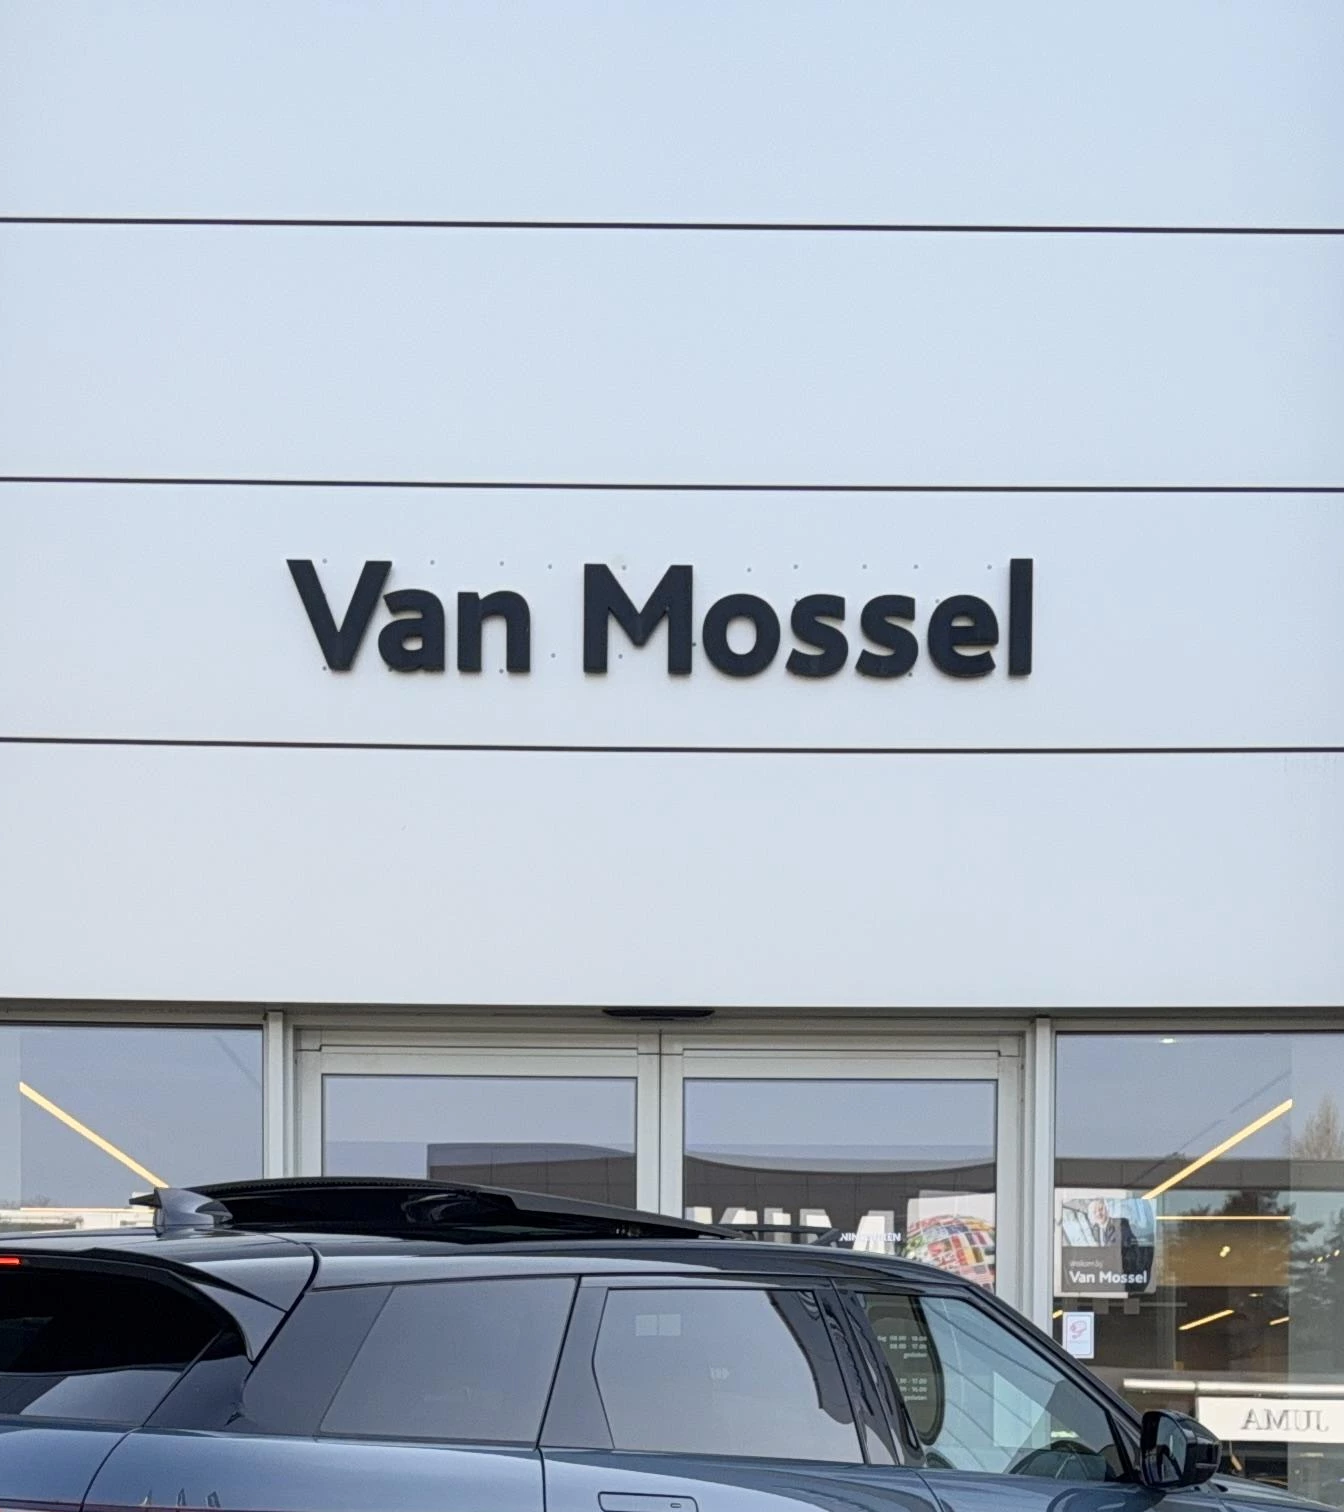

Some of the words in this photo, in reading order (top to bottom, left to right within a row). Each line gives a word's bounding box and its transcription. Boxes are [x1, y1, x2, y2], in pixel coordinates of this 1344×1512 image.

[286, 559, 531, 673] Van
[583, 558, 1034, 677] Mossel
[1069, 1270, 1096, 1284] Van
[1099, 1270, 1148, 1284] Mossel
